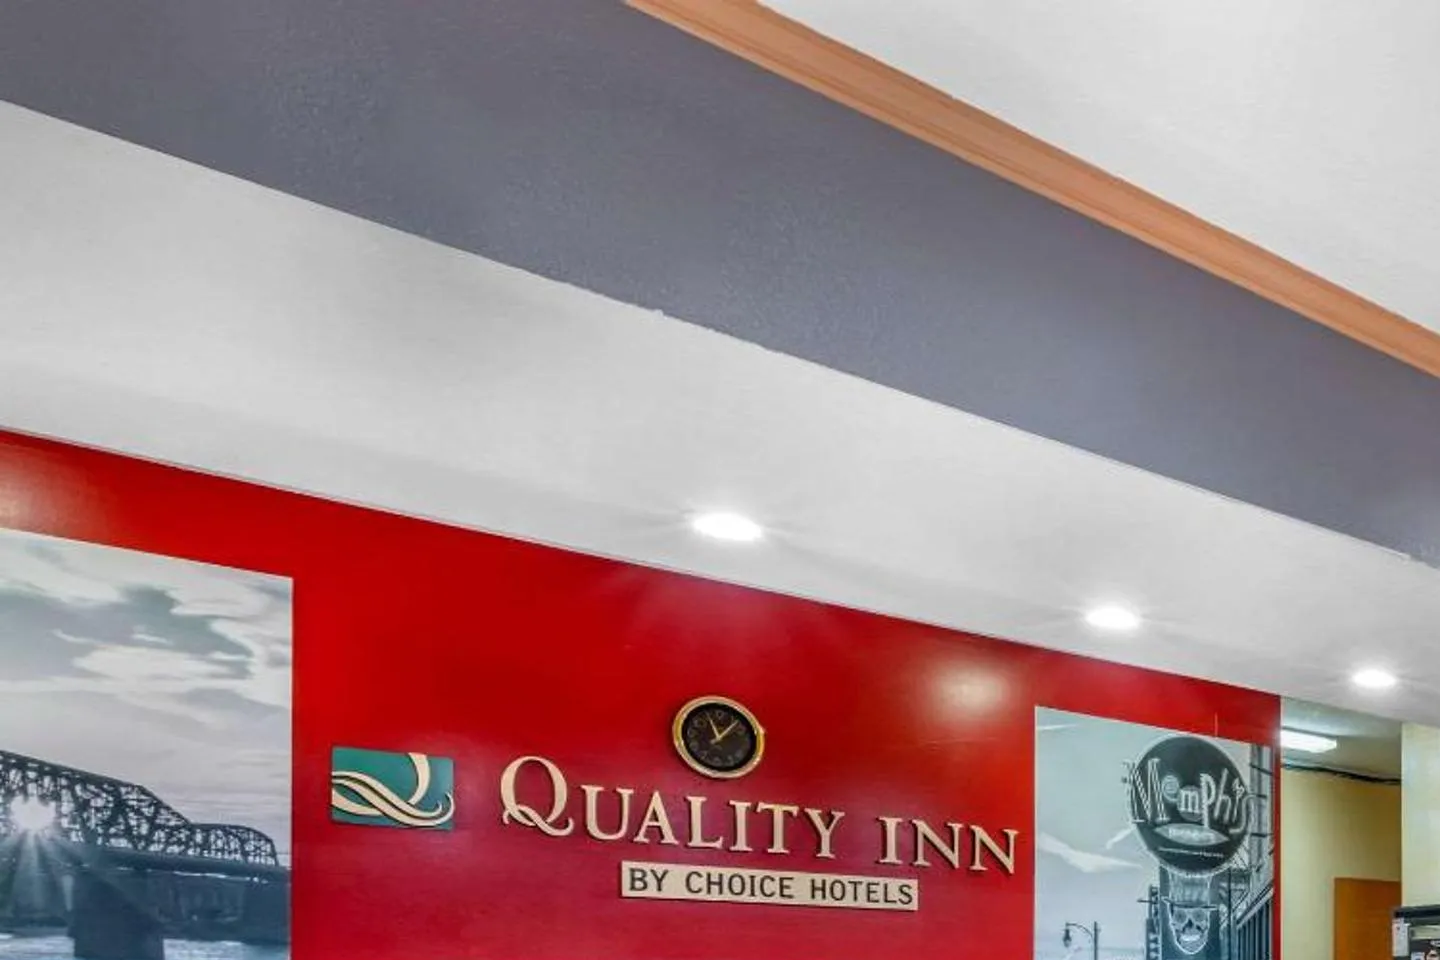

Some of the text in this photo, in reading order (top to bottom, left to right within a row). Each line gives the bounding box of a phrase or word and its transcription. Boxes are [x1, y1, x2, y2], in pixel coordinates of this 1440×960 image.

[500, 756, 1018, 874] QUALITY INN
[628, 868, 914, 907] BY CHOICE HOTELS
